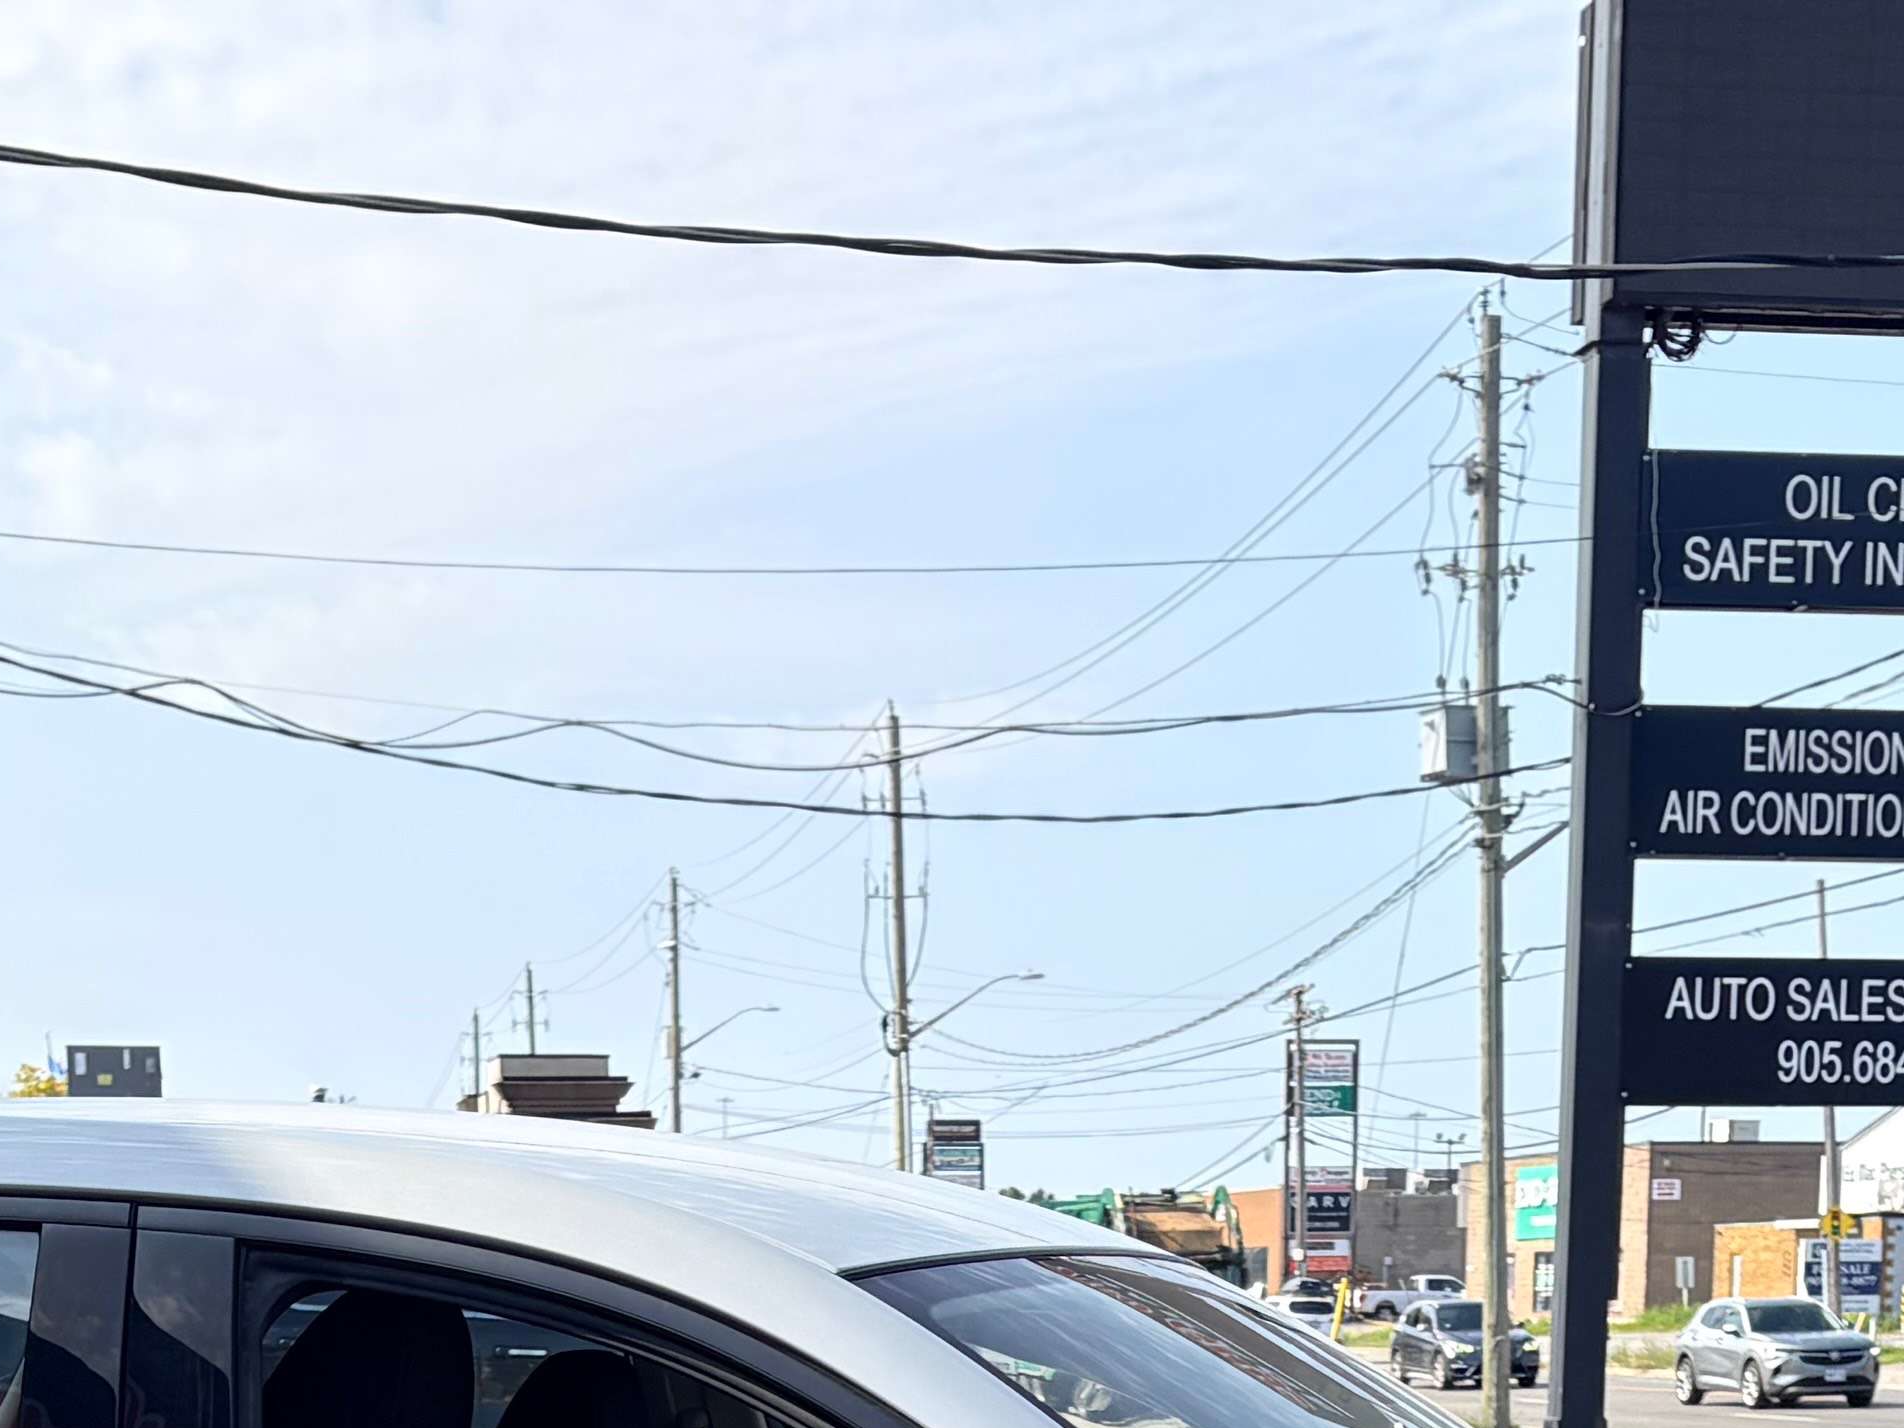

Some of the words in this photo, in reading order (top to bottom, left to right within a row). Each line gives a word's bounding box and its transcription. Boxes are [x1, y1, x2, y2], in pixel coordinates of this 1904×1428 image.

[1785, 474, 1855, 521] OIL
[1683, 535, 1853, 585] SAFETY
[1659, 789, 1721, 834] AIR
[1664, 976, 1776, 1021] AUTO
